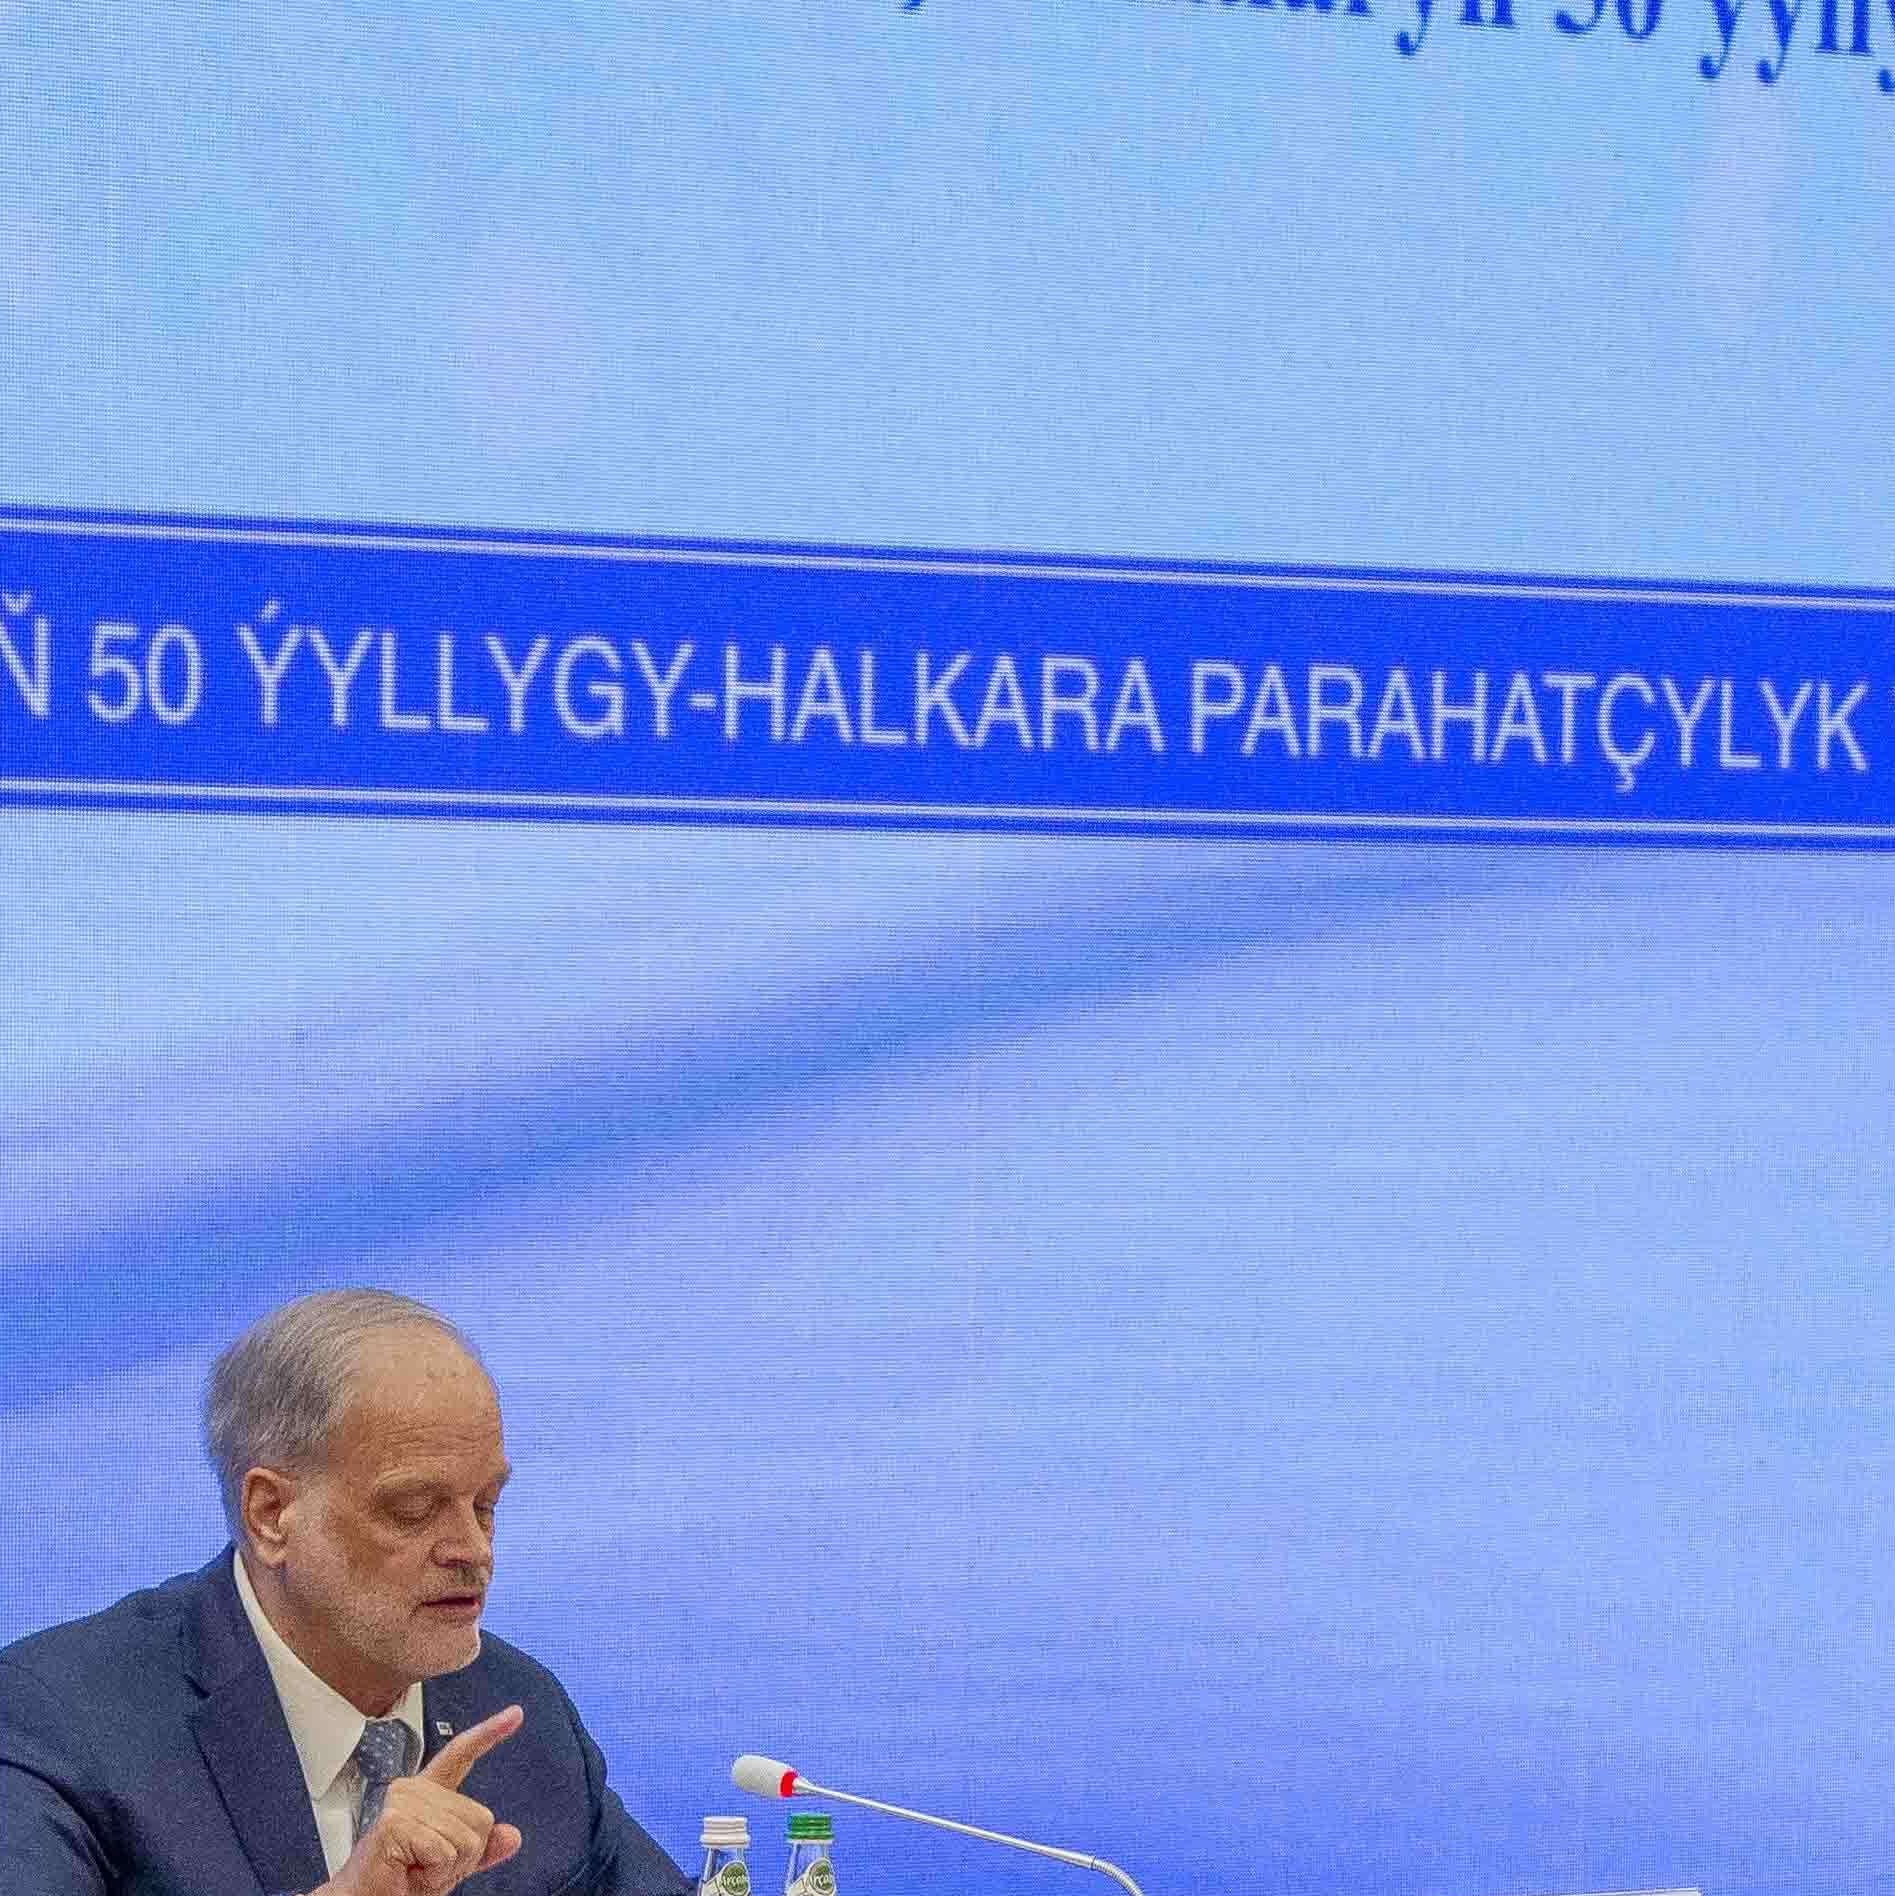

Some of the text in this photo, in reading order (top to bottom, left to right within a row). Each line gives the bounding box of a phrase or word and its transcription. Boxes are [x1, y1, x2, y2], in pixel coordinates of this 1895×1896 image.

[86, 619, 204, 726] 50
[235, 599, 1167, 753] ÝYLLYGY-HALKARA
[1189, 659, 1869, 792] PARAHATÇYLYK
